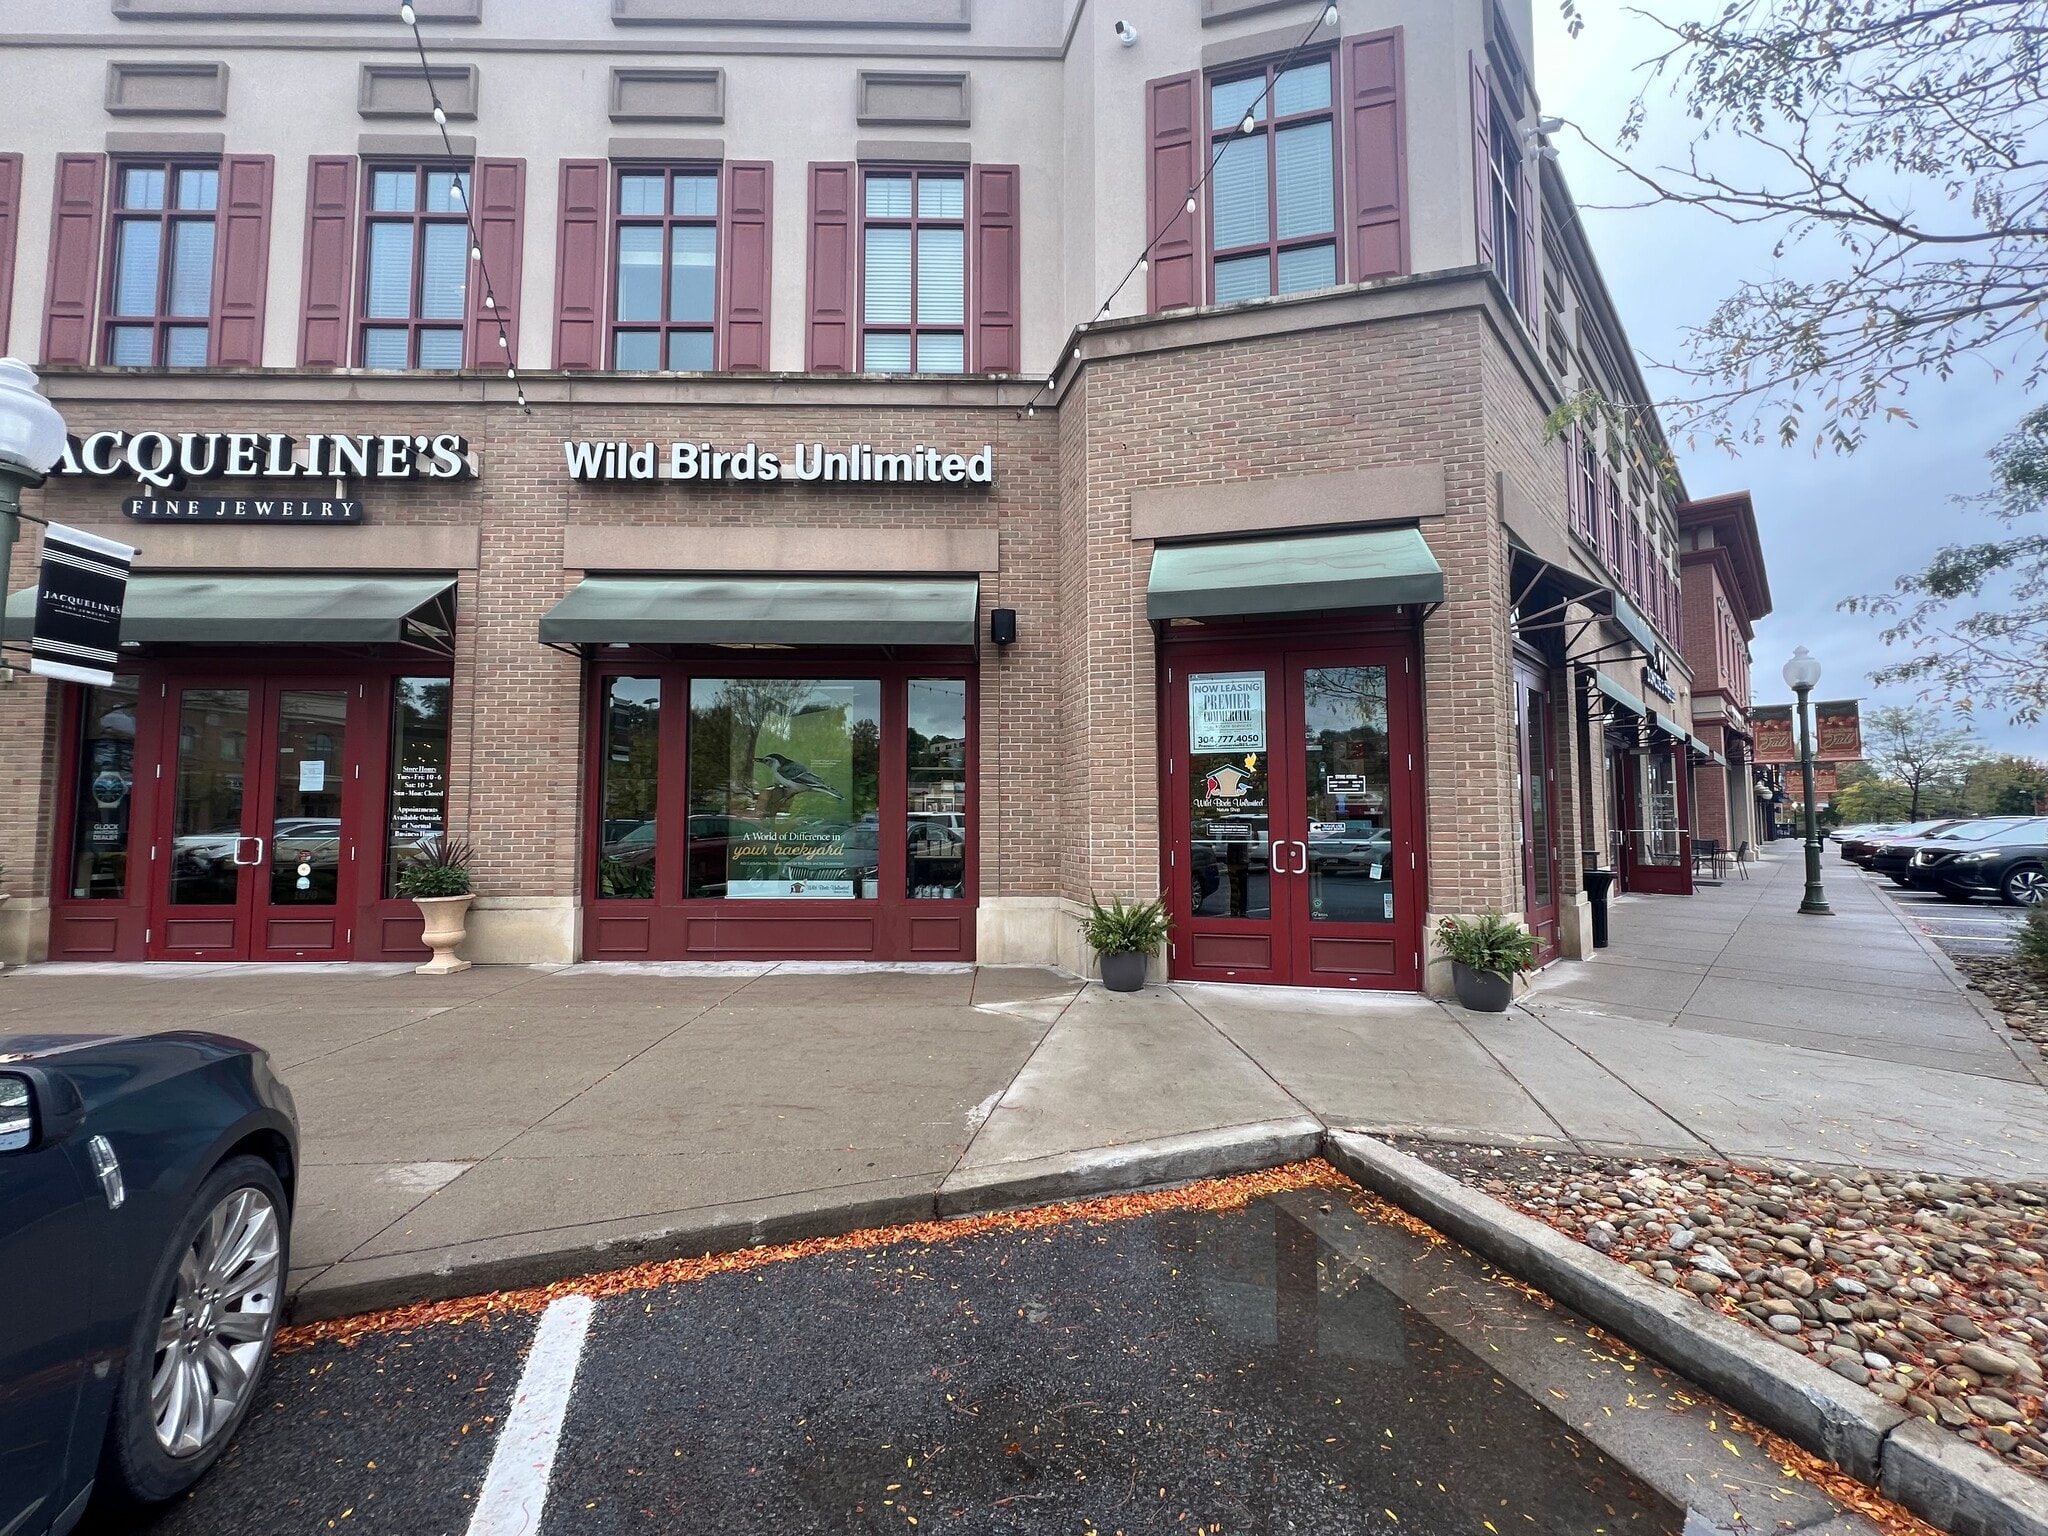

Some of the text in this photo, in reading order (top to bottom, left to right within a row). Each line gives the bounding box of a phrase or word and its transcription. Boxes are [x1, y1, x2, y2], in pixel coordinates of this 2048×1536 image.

[46, 430, 463, 487] ACQUELINE'S
[563, 441, 993, 483] Wild Birds Unlimited
[131, 500, 354, 518] FINE JEWELRY
[43, 590, 121, 615] JACQUELINE'S
[1194, 683, 1260, 694] NOW LEASING
[1204, 693, 1251, 711] PREMIER
[1203, 709, 1252, 723] COMMERCIAL
[1197, 734, 1259, 744] 304.777.4050
[397, 806, 439, 814] Appointments
[1192, 798, 1265, 808] Wild Birds Unlimited
[742, 831, 841, 841] A World of Difference in
[732, 842, 845, 860] your backyard
